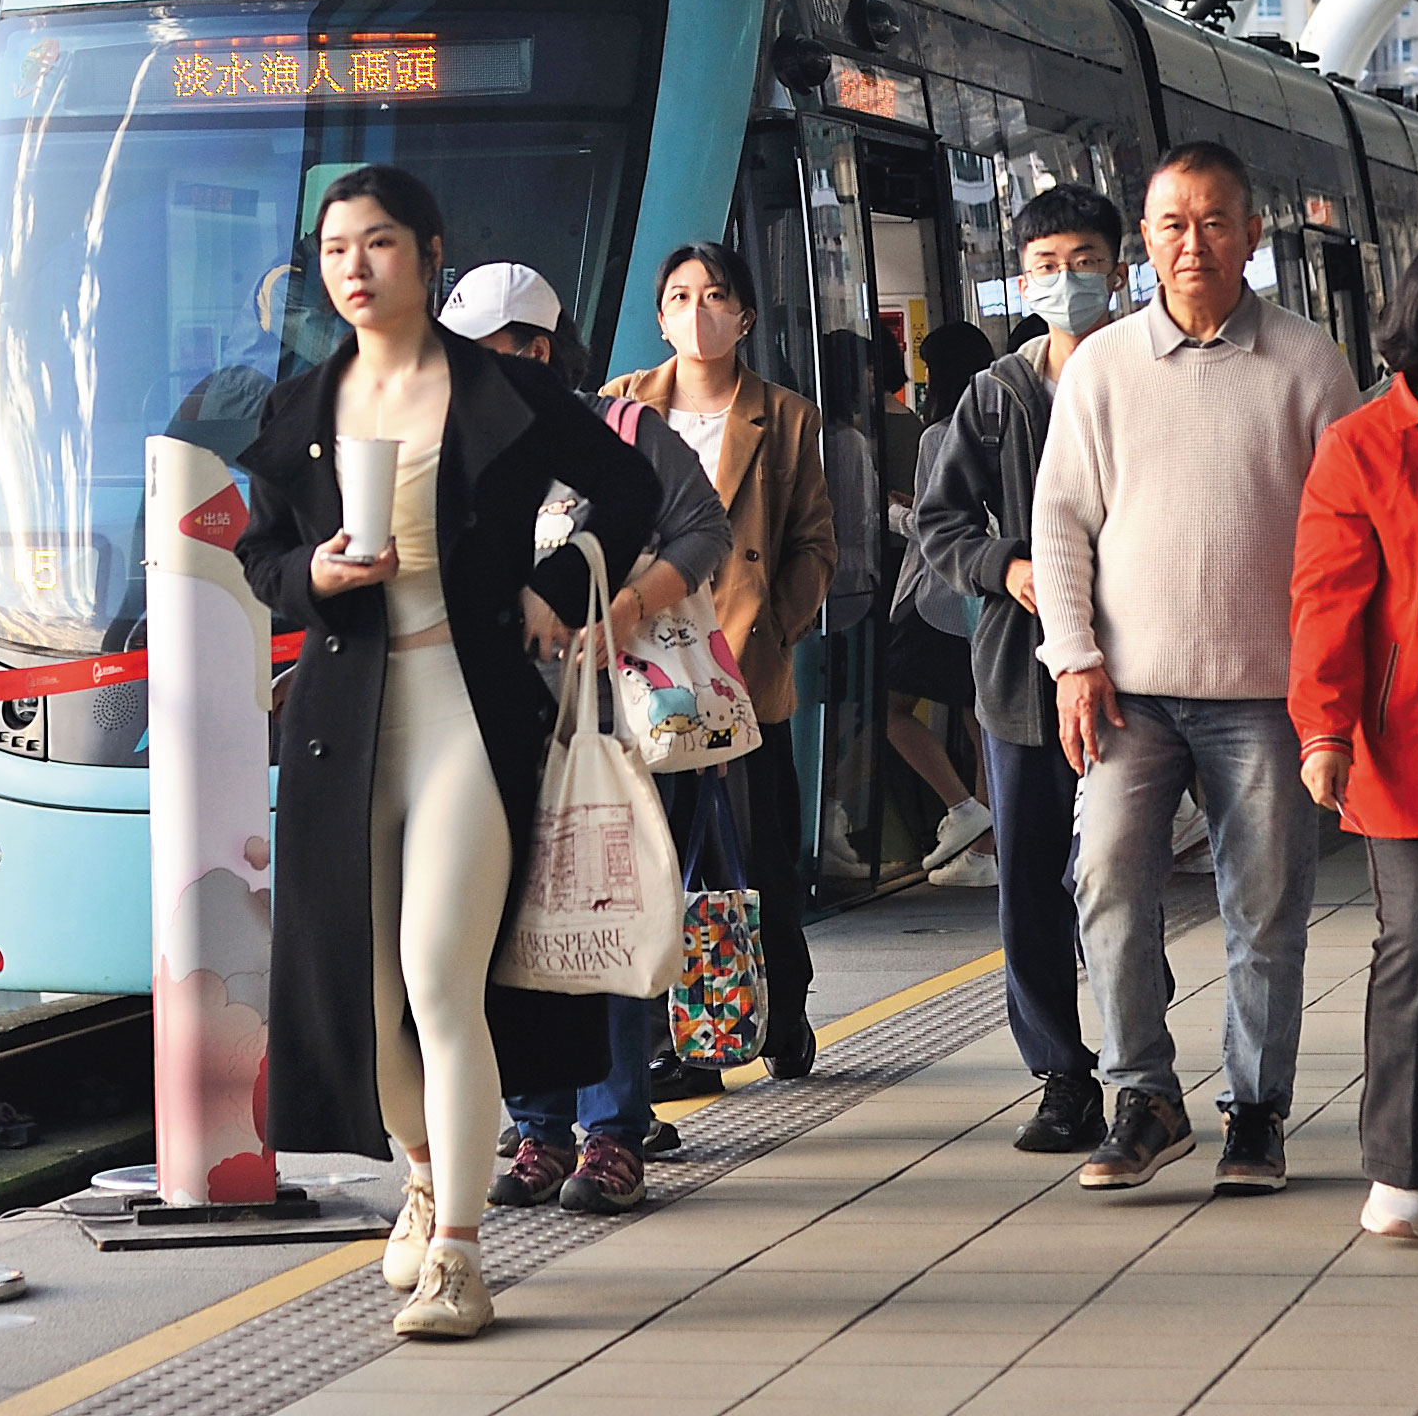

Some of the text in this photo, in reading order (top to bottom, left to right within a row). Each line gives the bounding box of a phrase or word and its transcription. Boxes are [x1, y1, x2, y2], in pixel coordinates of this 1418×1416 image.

[173, 45, 438, 99] 淡水漁人碼頭
[203, 512, 231, 526] 出站
[513, 927, 625, 954] HAKESPEARE
